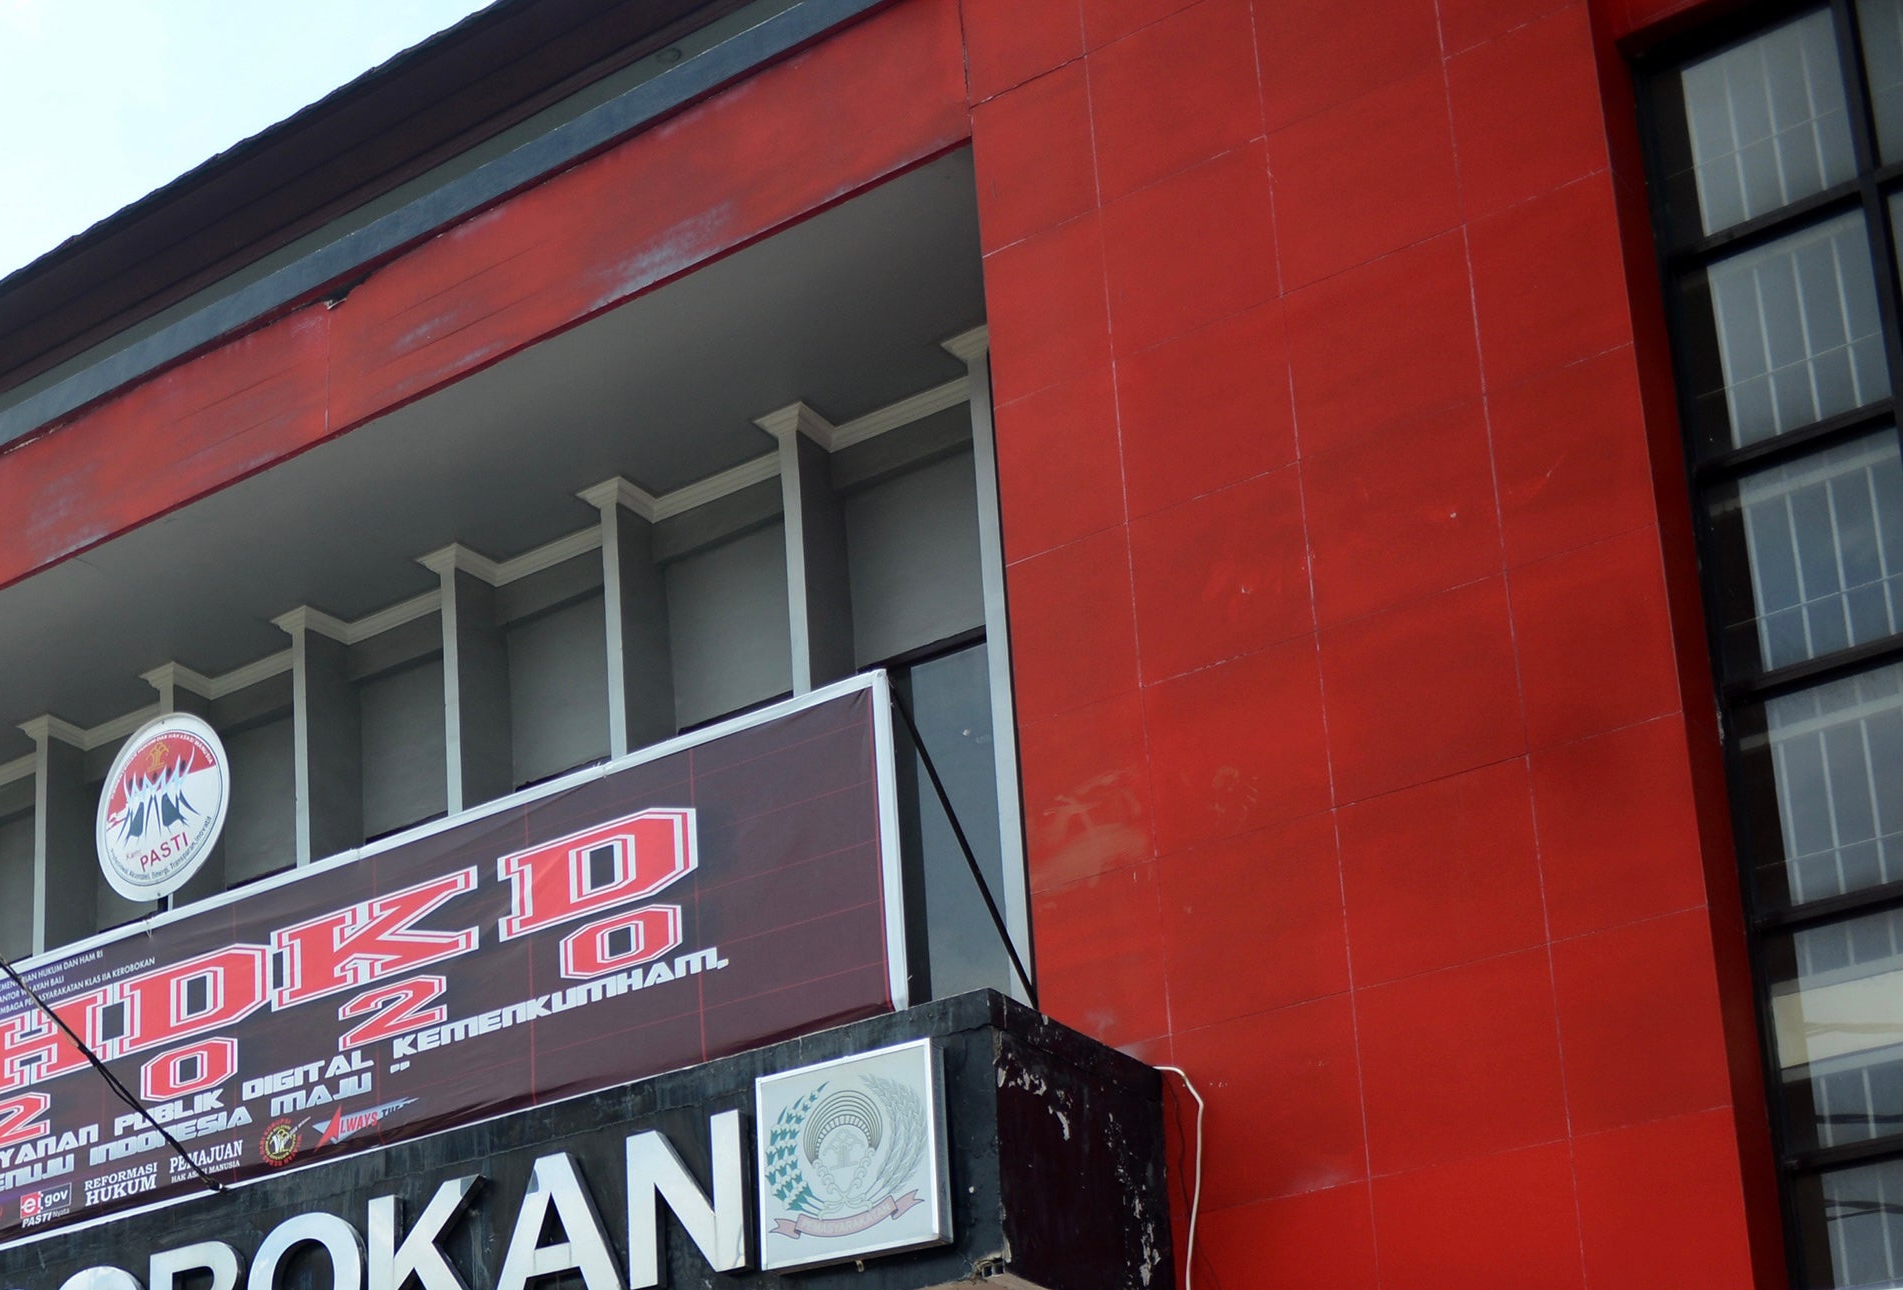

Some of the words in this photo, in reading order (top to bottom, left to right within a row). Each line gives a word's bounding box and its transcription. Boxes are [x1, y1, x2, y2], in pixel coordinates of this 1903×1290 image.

[139, 832, 189, 872] PASTI
[38, 964, 62, 978] HUKUM
[64, 959, 78, 970] DAN
[80, 954, 95, 965] HAM
[96, 951, 103, 959] RI
[85, 976, 101, 987] KLAS
[102, 972, 111, 981] IIA
[113, 958, 155, 978] KEROBOKAN
[51, 977, 64, 987] BALI
[114, 1088, 225, 1136] PUBLIK
[242, 1049, 374, 1101] DIGITAL
[392, 946, 729, 1058] KEMENKUMHAM,
[271, 1072, 372, 1117] MAJU
[169, 1140, 243, 1174] PEMAJUAN
[171, 1173, 186, 1183] HAK
[208, 1160, 241, 1174] MANUSIA
[84, 1162, 158, 1192] REFORMASI
[86, 1174, 158, 1206] HUKUM
[44, 1189, 69, 1207] gov
[21, 1211, 53, 1228] PASTI
